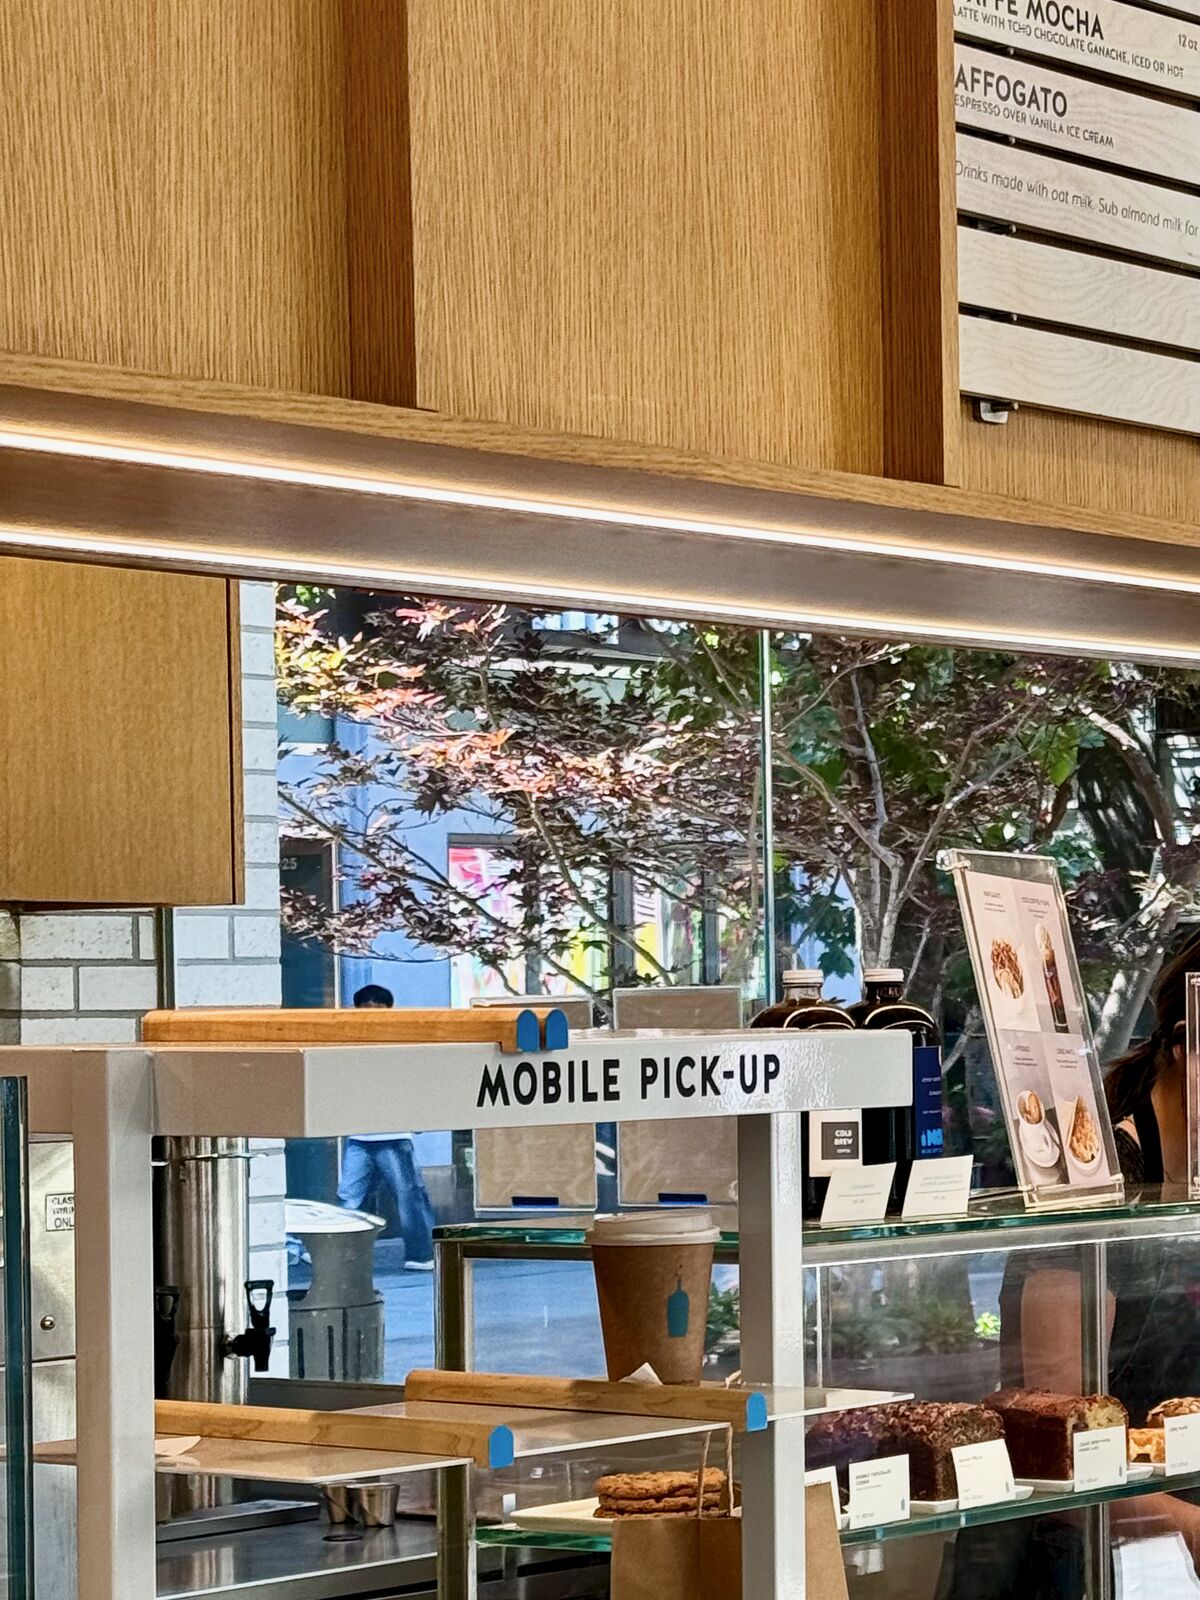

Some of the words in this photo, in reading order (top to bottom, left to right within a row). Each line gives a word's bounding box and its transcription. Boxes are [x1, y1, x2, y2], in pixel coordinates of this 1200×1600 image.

[982, 12, 1005, 30] WITH
[1034, 27, 1085, 52] CHOCOLATE
[1087, 43, 1130, 66] GANACHE,
[1132, 54, 1151, 70] ICED
[1153, 58, 1165, 73] OR
[1026, 0, 1104, 39] MOCHA
[1178, 33, 1187, 47] 12
[1188, 40, 1198, 51] oz
[955, 64, 1068, 118] AFFOGATO
[1003, 108, 1027, 125] OVER
[1029, 114, 1064, 135] VANILLA
[1067, 125, 1080, 140] ICE
[1083, 129, 1114, 148] CREAM
[955, 160, 989, 184] Drinks
[991, 171, 1023, 192] made
[1027, 176, 1048, 199] with
[1051, 187, 1069, 205] oat
[1098, 197, 1118, 217] Sub
[1121, 203, 1159, 227] almond
[1162, 212, 1182, 232] milk
[1184, 216, 1198, 237] for
[476, 1057, 620, 1107] MOBILE
[641, 1053, 780, 1100] PICK-UP
[54, 1217, 75, 1228] ONL
